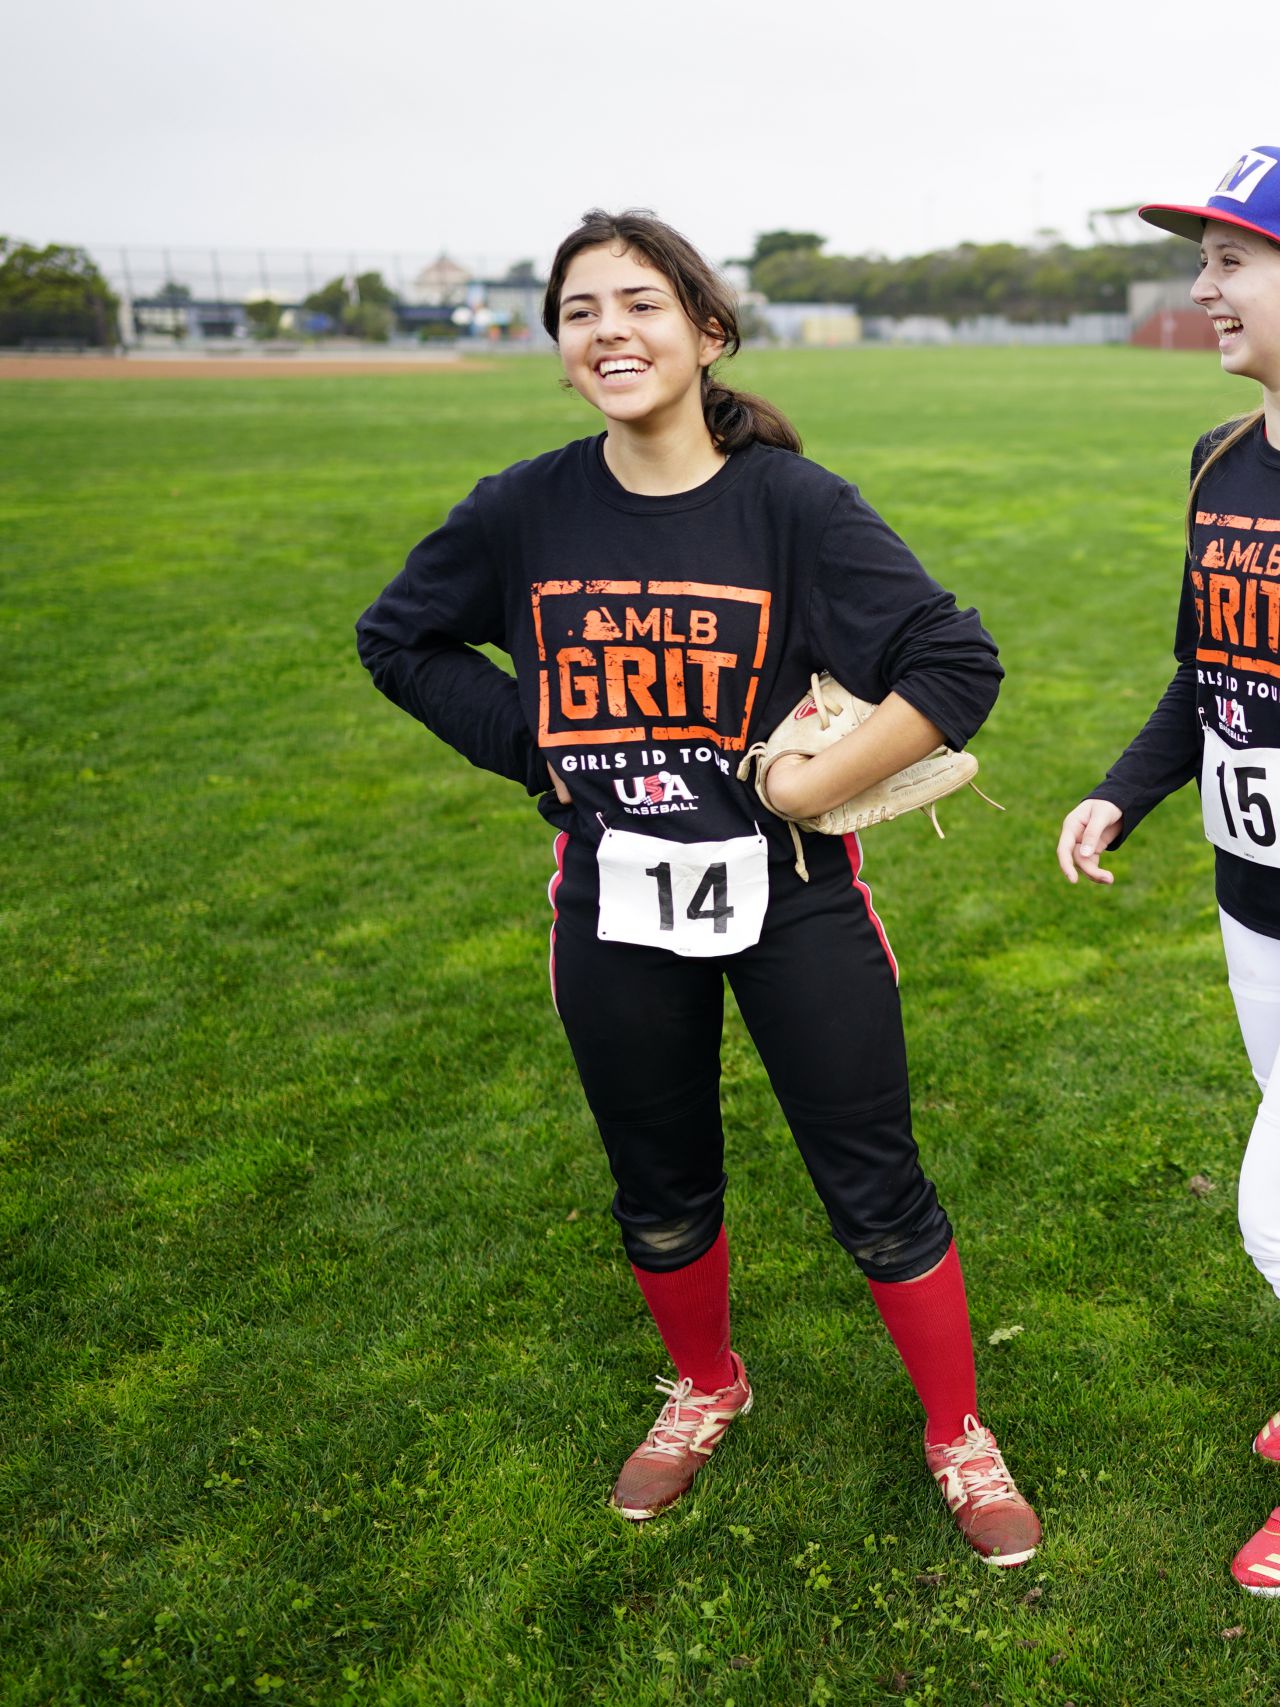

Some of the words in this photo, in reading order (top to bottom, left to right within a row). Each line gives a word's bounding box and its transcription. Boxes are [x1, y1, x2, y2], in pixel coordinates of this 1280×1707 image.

[625, 606, 718, 645] MLB
[556, 646, 738, 723] GRIT
[1226, 675, 1238, 692] ID
[562, 752, 627, 772] GIRLS
[641, 750, 667, 766] ID
[680, 747, 730, 775] TOUR
[613, 771, 694, 806] USA
[1216, 760, 1276, 847] 15
[623, 802, 698, 816] BASEBALL
[645, 861, 734, 934] 14
